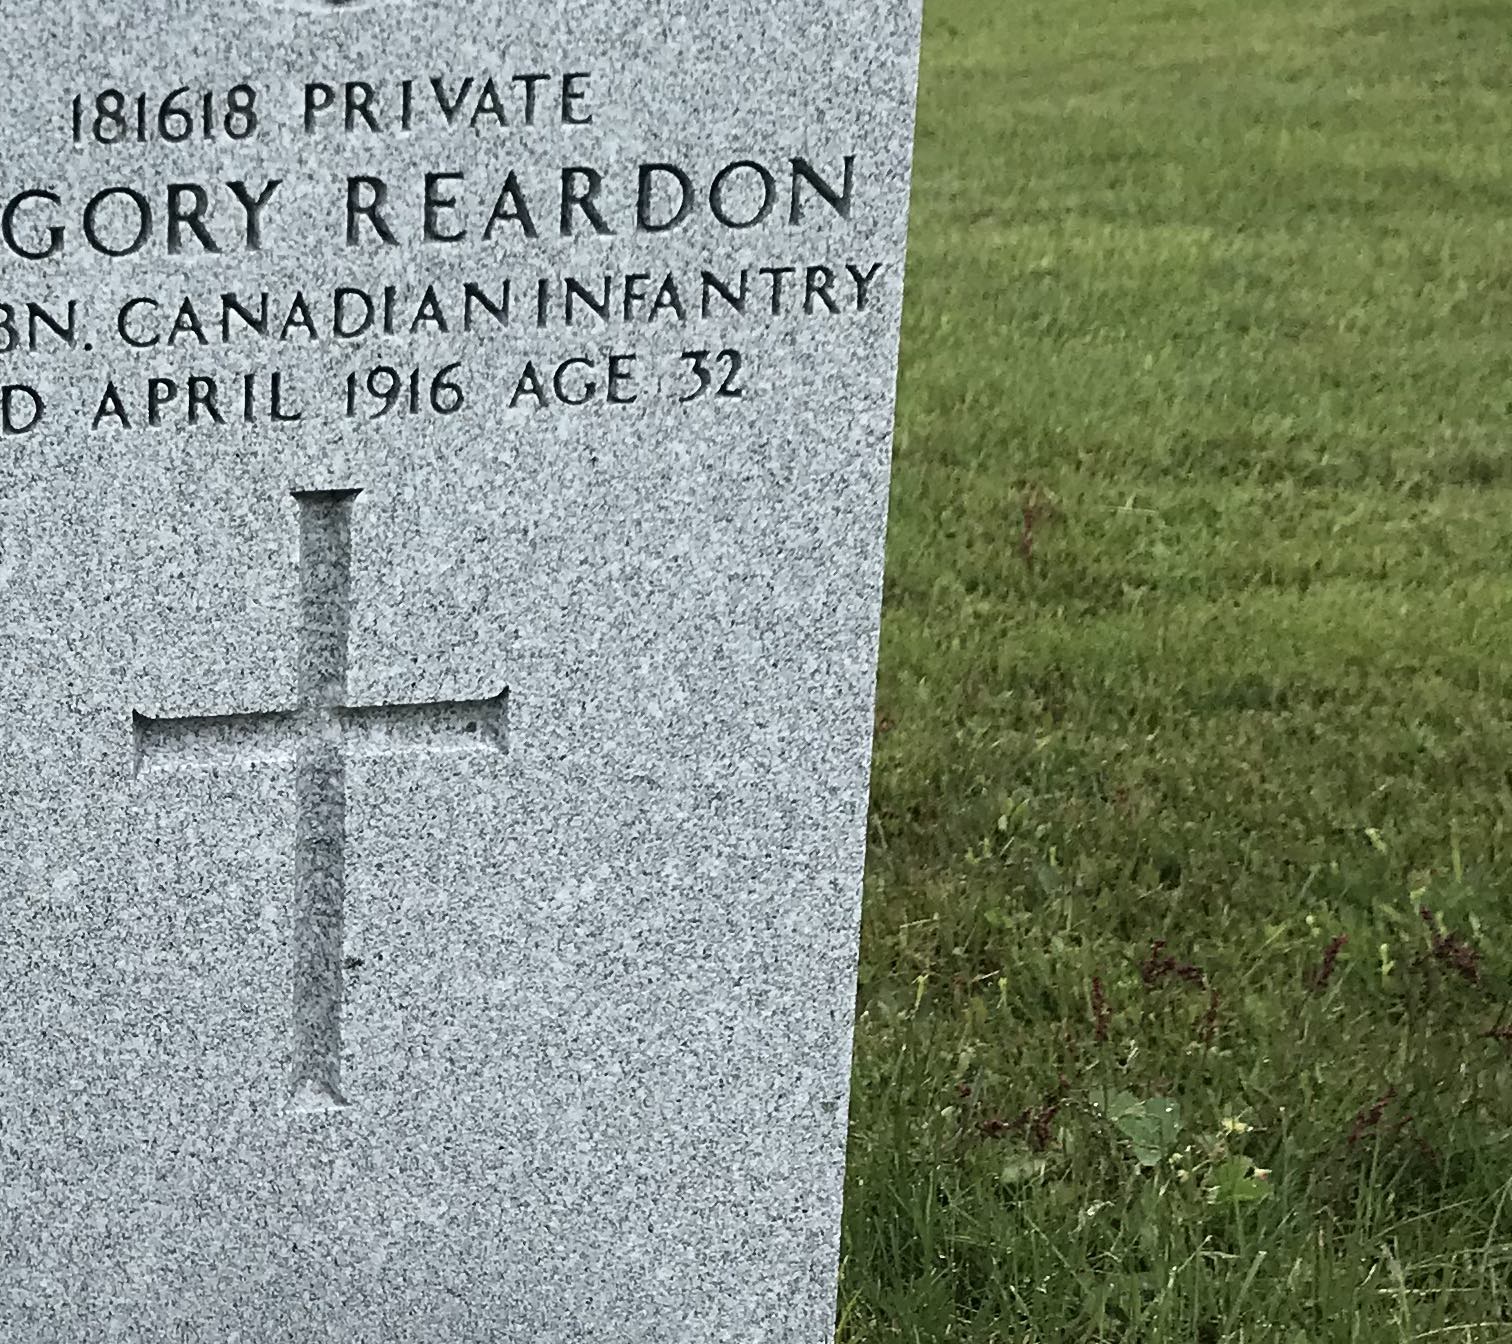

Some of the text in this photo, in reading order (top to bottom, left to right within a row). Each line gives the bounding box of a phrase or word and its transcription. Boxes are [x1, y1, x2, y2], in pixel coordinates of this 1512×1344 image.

[70, 72, 591, 145] 181618 PRIVATE
[345, 156, 856, 246] REARDON
[117, 278, 510, 348] CANADIAN
[536, 262, 882, 328] INFANTRY
[91, 371, 303, 431] APRIL
[345, 362, 465, 420] 1916
[509, 353, 638, 408] AGE
[678, 349, 743, 402] 32
